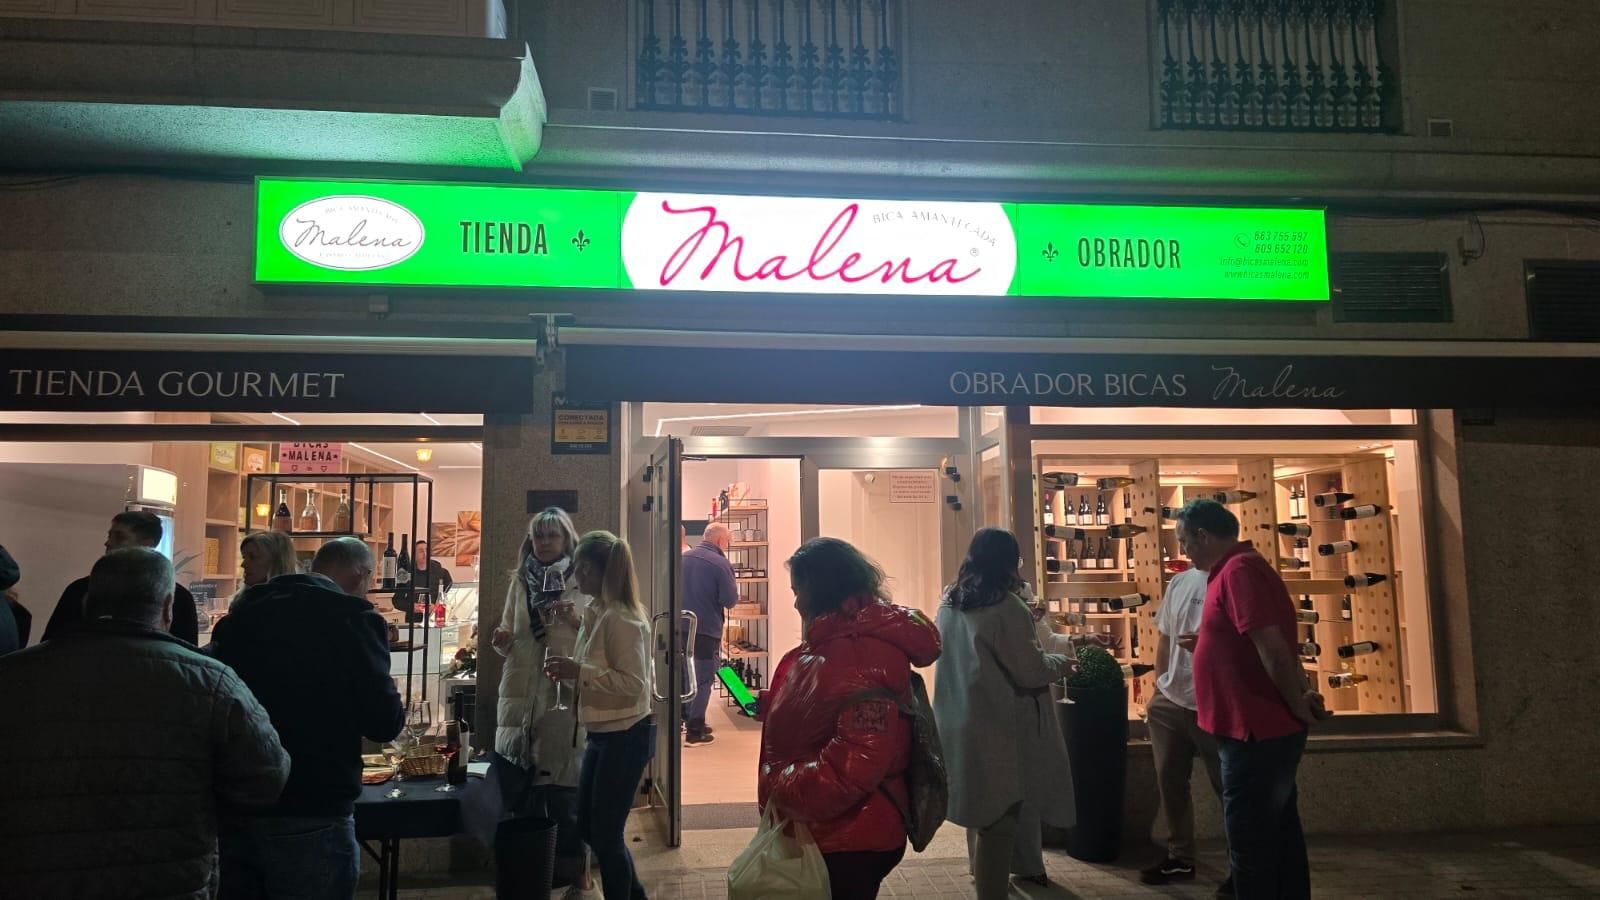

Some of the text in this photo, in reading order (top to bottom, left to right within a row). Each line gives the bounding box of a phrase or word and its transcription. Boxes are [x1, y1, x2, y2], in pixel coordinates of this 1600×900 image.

[872, 210, 904, 224] BICA
[294, 218, 412, 248] Malena
[460, 220, 548, 255] TIENDA
[659, 200, 982, 286] Malena
[1077, 237, 1181, 269] OBRADOR
[1255, 243, 1309, 255] 609 652 120
[9, 369, 344, 398] TIENDA GOURMET
[949, 364, 1344, 401] OBRADOR BICAS Malena
[288, 450, 332, 461] MALENA
